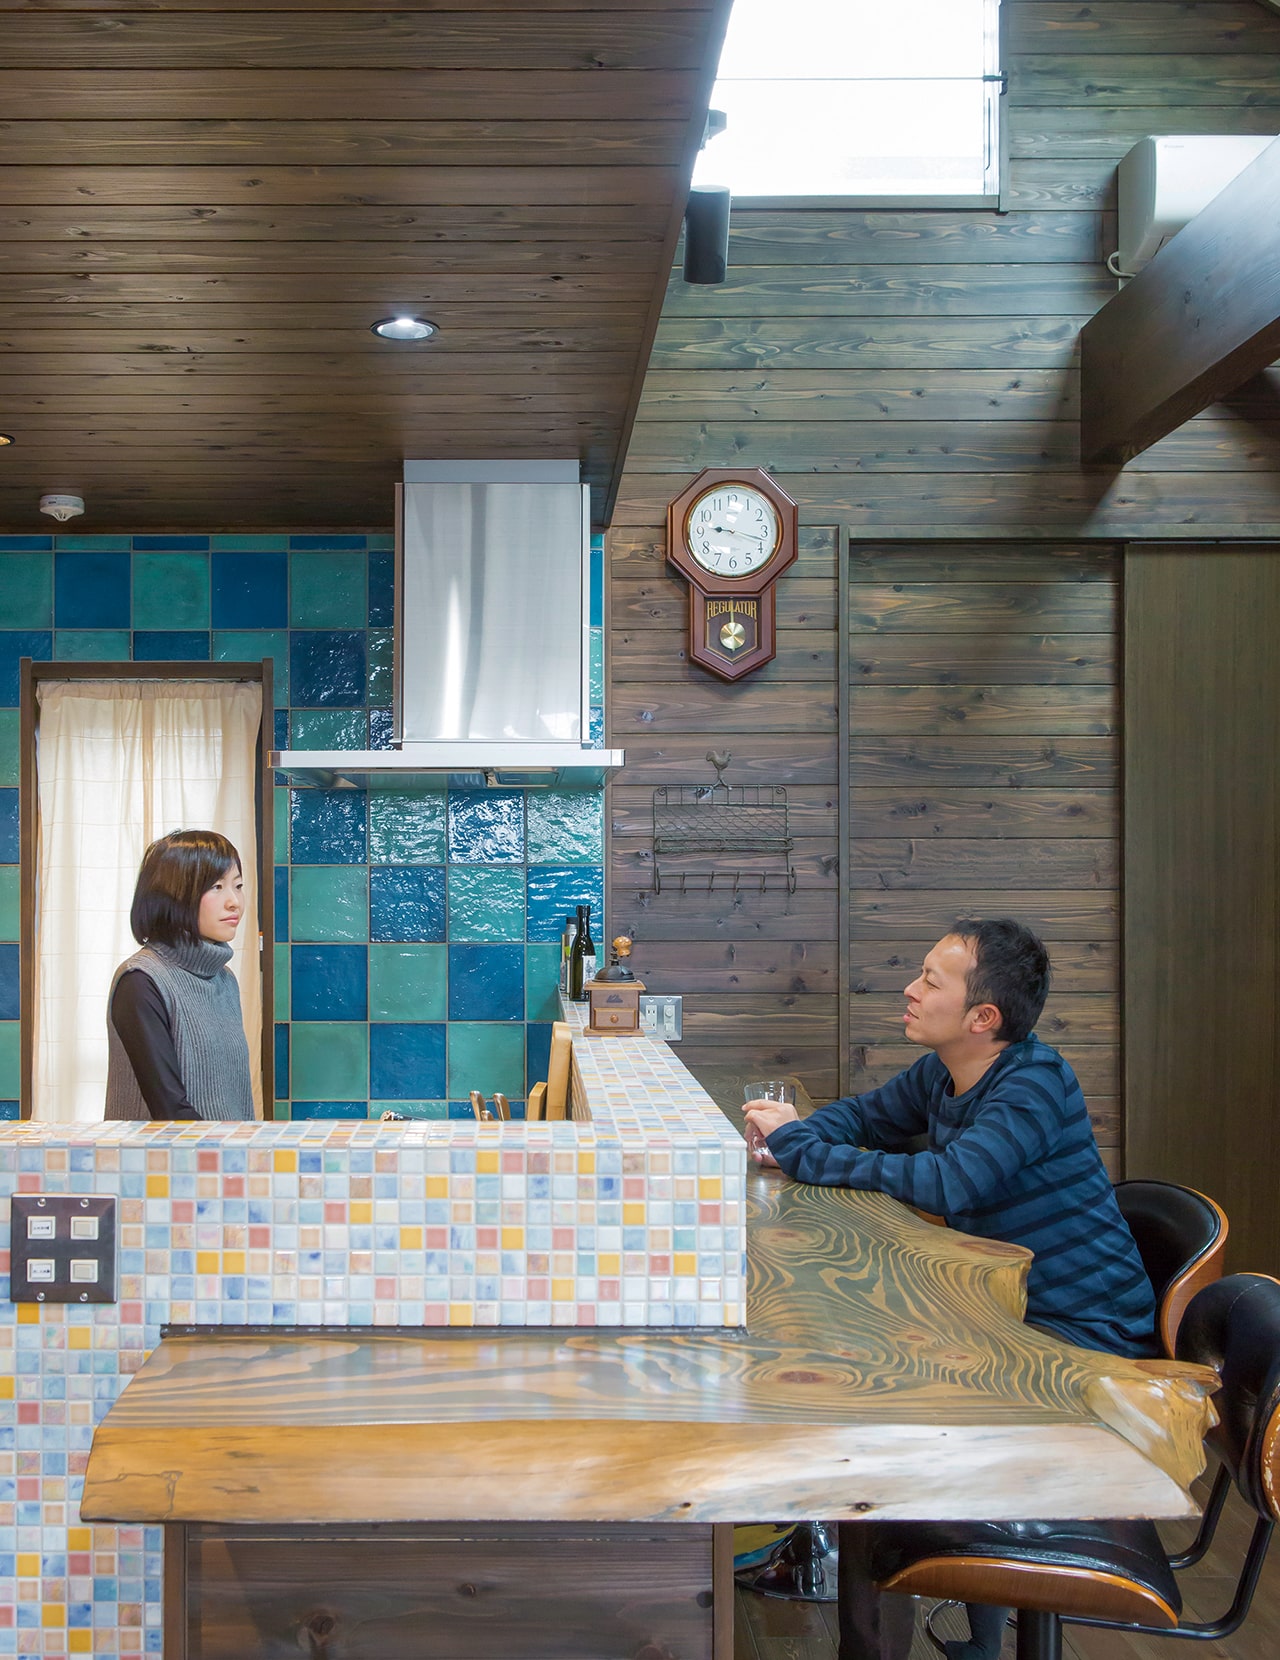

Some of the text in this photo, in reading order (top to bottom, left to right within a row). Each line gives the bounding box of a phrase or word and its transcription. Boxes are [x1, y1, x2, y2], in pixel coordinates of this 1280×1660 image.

[713, 499, 721, 511] 11
[746, 499, 750, 511] 1
[701, 510, 712, 522] 10
[755, 509, 763, 521] 2
[697, 526, 704, 538] 9
[761, 525, 768, 538] 3
[702, 541, 710, 554] 8
[757, 542, 763, 554] 4
[714, 553, 722, 566] 7
[729, 556, 737, 569] 6
[745, 553, 752, 565] 5
[707, 600, 757, 620] REGULATOR
